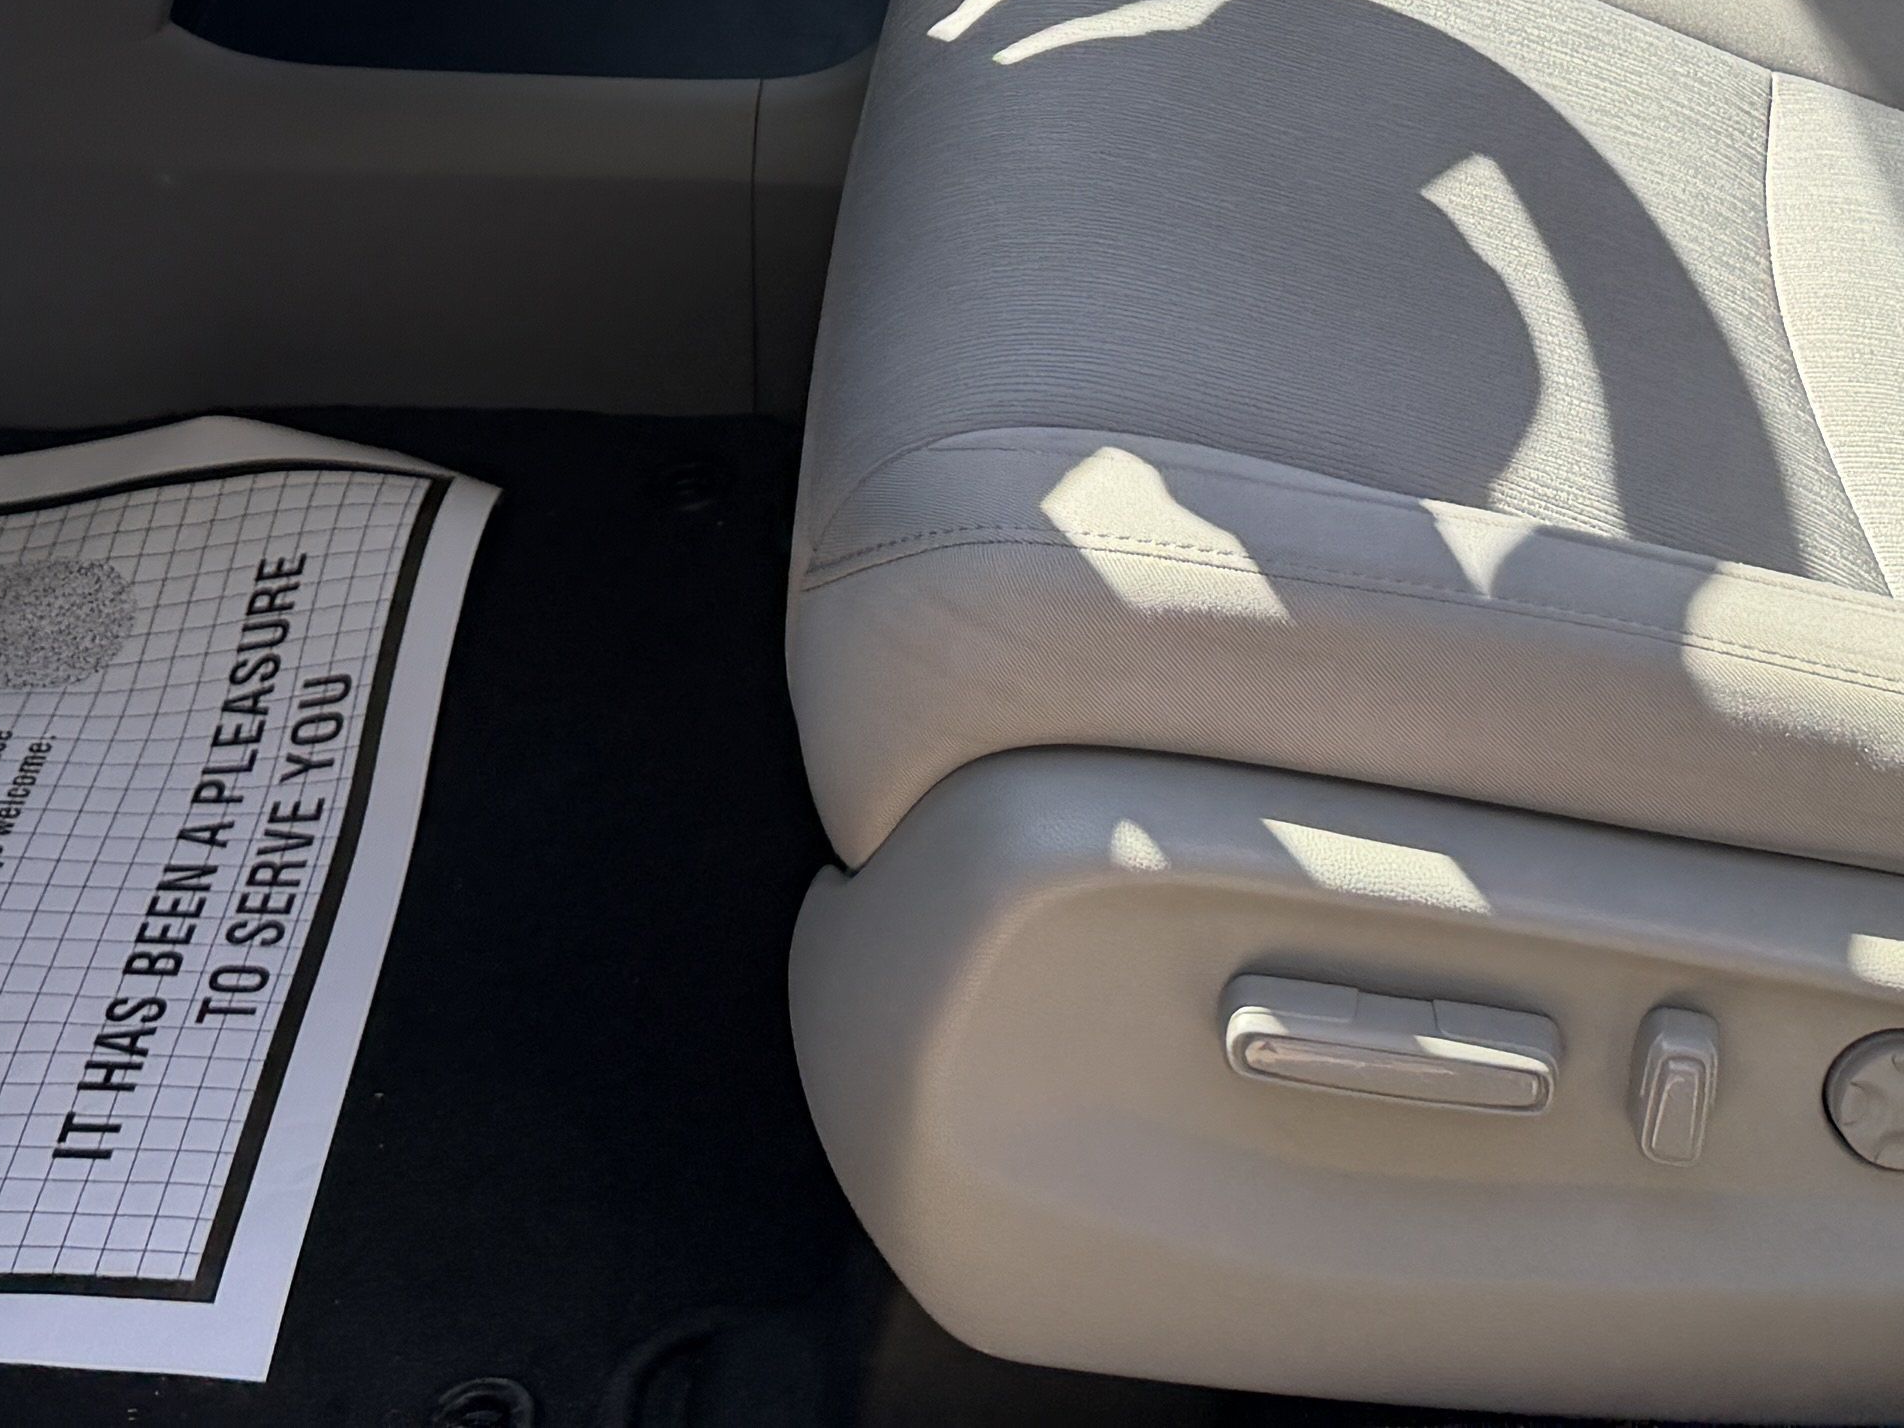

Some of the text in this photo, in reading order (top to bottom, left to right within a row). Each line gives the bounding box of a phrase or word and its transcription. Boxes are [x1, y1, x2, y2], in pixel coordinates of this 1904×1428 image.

[51, 552, 307, 1160] IT HAS BEEN A PLEASURE
[195, 673, 353, 1024] TO SERVE YOU
